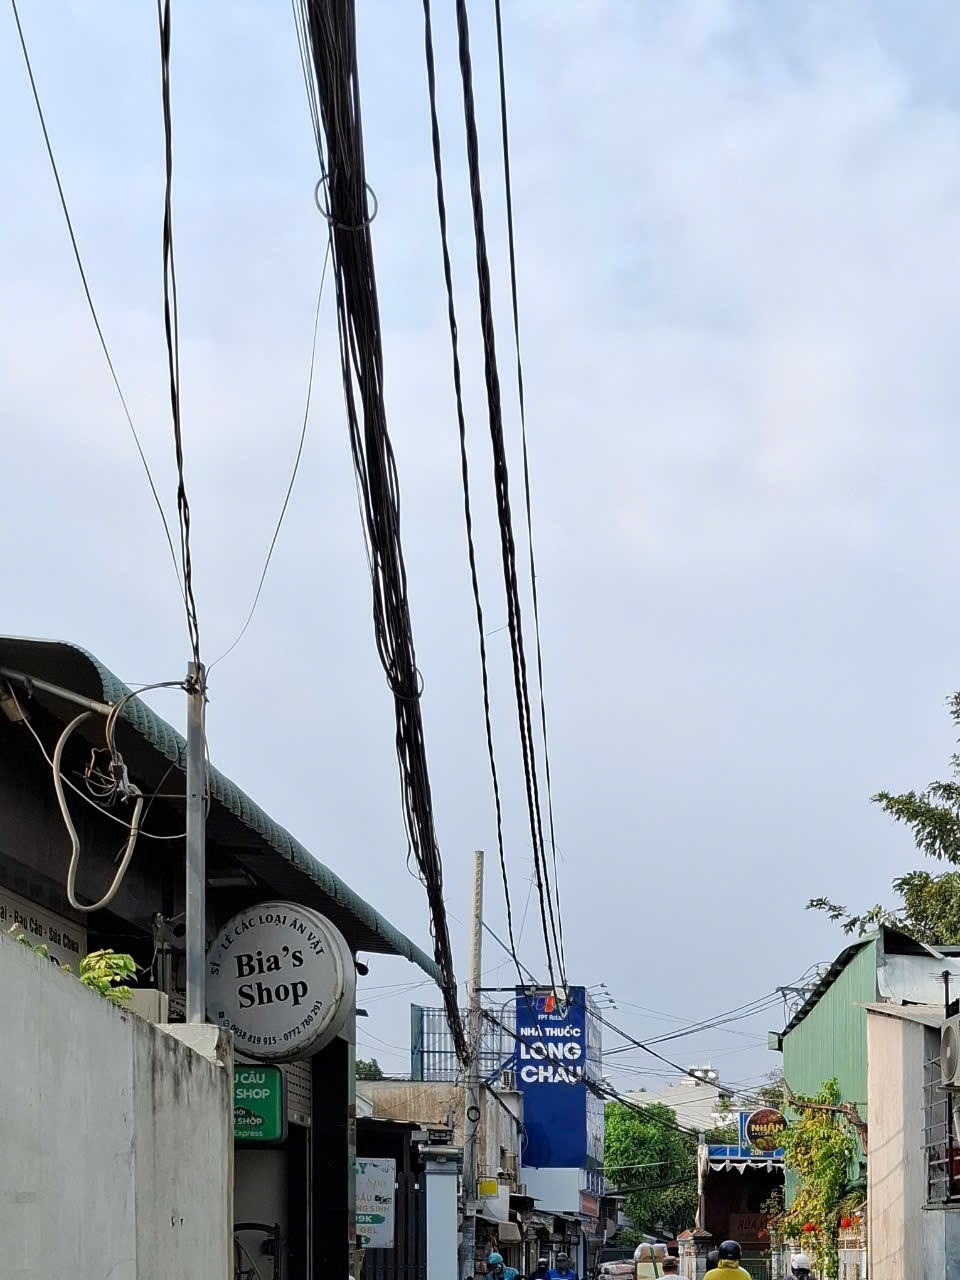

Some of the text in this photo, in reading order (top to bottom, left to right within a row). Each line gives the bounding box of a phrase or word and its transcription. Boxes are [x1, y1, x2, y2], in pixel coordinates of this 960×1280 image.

[234, 918, 256, 936] CÁC
[258, 914, 287, 926] LOẠI
[289, 917, 307, 934] ĂN
[234, 946, 304, 979] Bia's
[238, 980, 308, 1009] Shop
[230, 1024, 247, 1040] 0938
[263, 1036, 276, 1046] 915
[283, 1026, 301, 1041] 0772
[301, 1014, 314, 1030] 780
[310, 1000, 323, 1016] 293
[520, 1024, 581, 1037] NHÀ THUỐC
[520, 1042, 582, 1060] LONG
[240, 1070, 265, 1084] CÂU
[520, 1062, 582, 1083] CHÂU
[236, 1088, 270, 1099] SHOP
[751, 1122, 784, 1132] NHÂN
